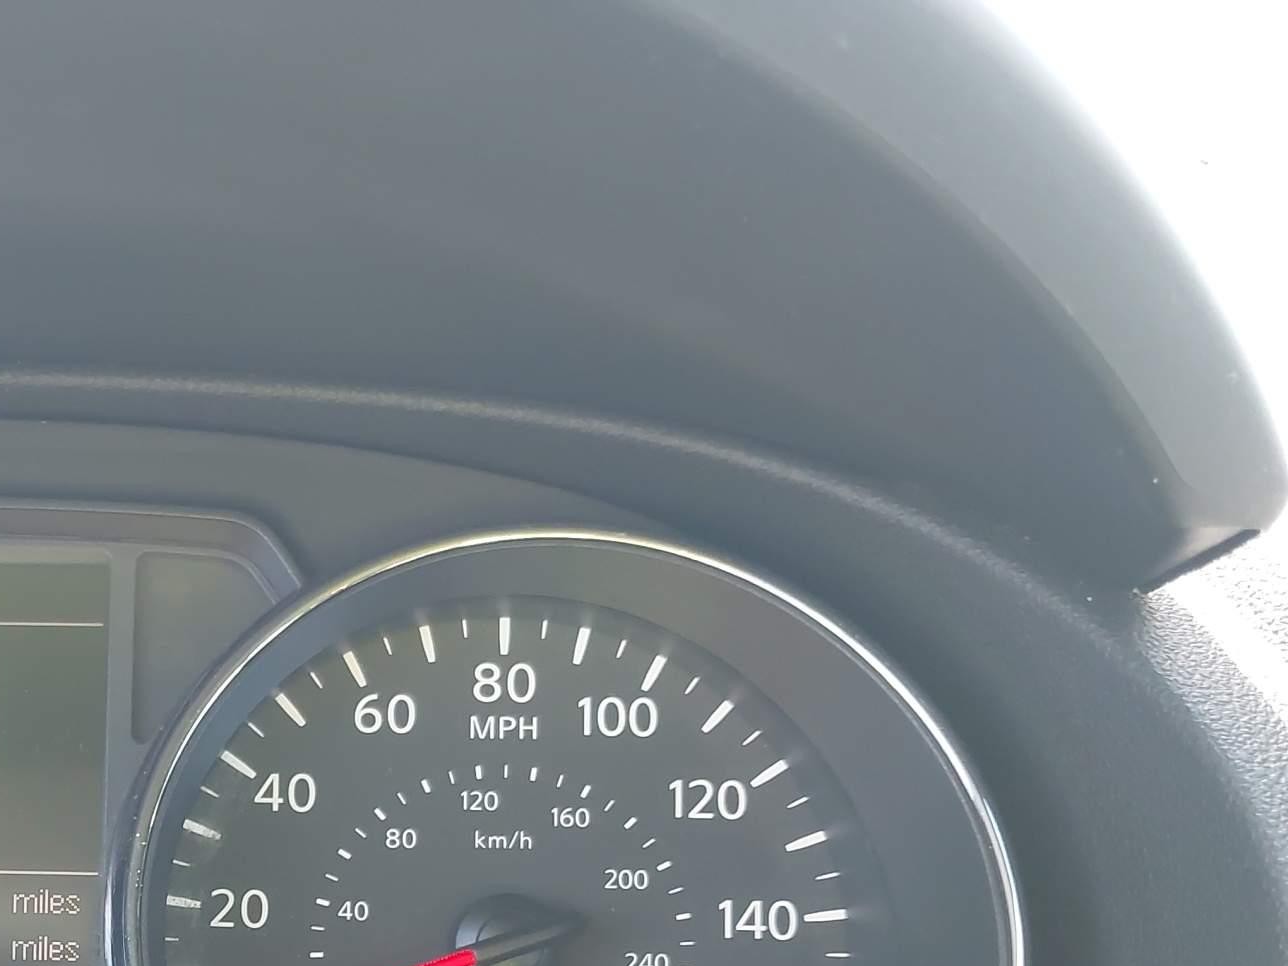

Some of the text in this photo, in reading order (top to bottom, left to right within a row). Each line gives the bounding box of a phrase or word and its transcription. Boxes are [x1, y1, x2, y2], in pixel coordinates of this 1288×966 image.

[471, 663, 536, 703] 80
[353, 694, 416, 734] 60
[577, 697, 658, 738] 100
[469, 715, 539, 741] MPH
[254, 773, 316, 813] 40
[460, 791, 499, 812] 120
[669, 780, 747, 820] 120
[551, 807, 589, 829] 160
[385, 829, 416, 849] 80
[474, 830, 533, 851] km/h
[604, 869, 649, 891] 200
[12, 890, 81, 916] miles
[210, 889, 269, 928] 20
[337, 901, 369, 922] 40
[718, 900, 797, 941] 140
[11, 938, 80, 963] miles
